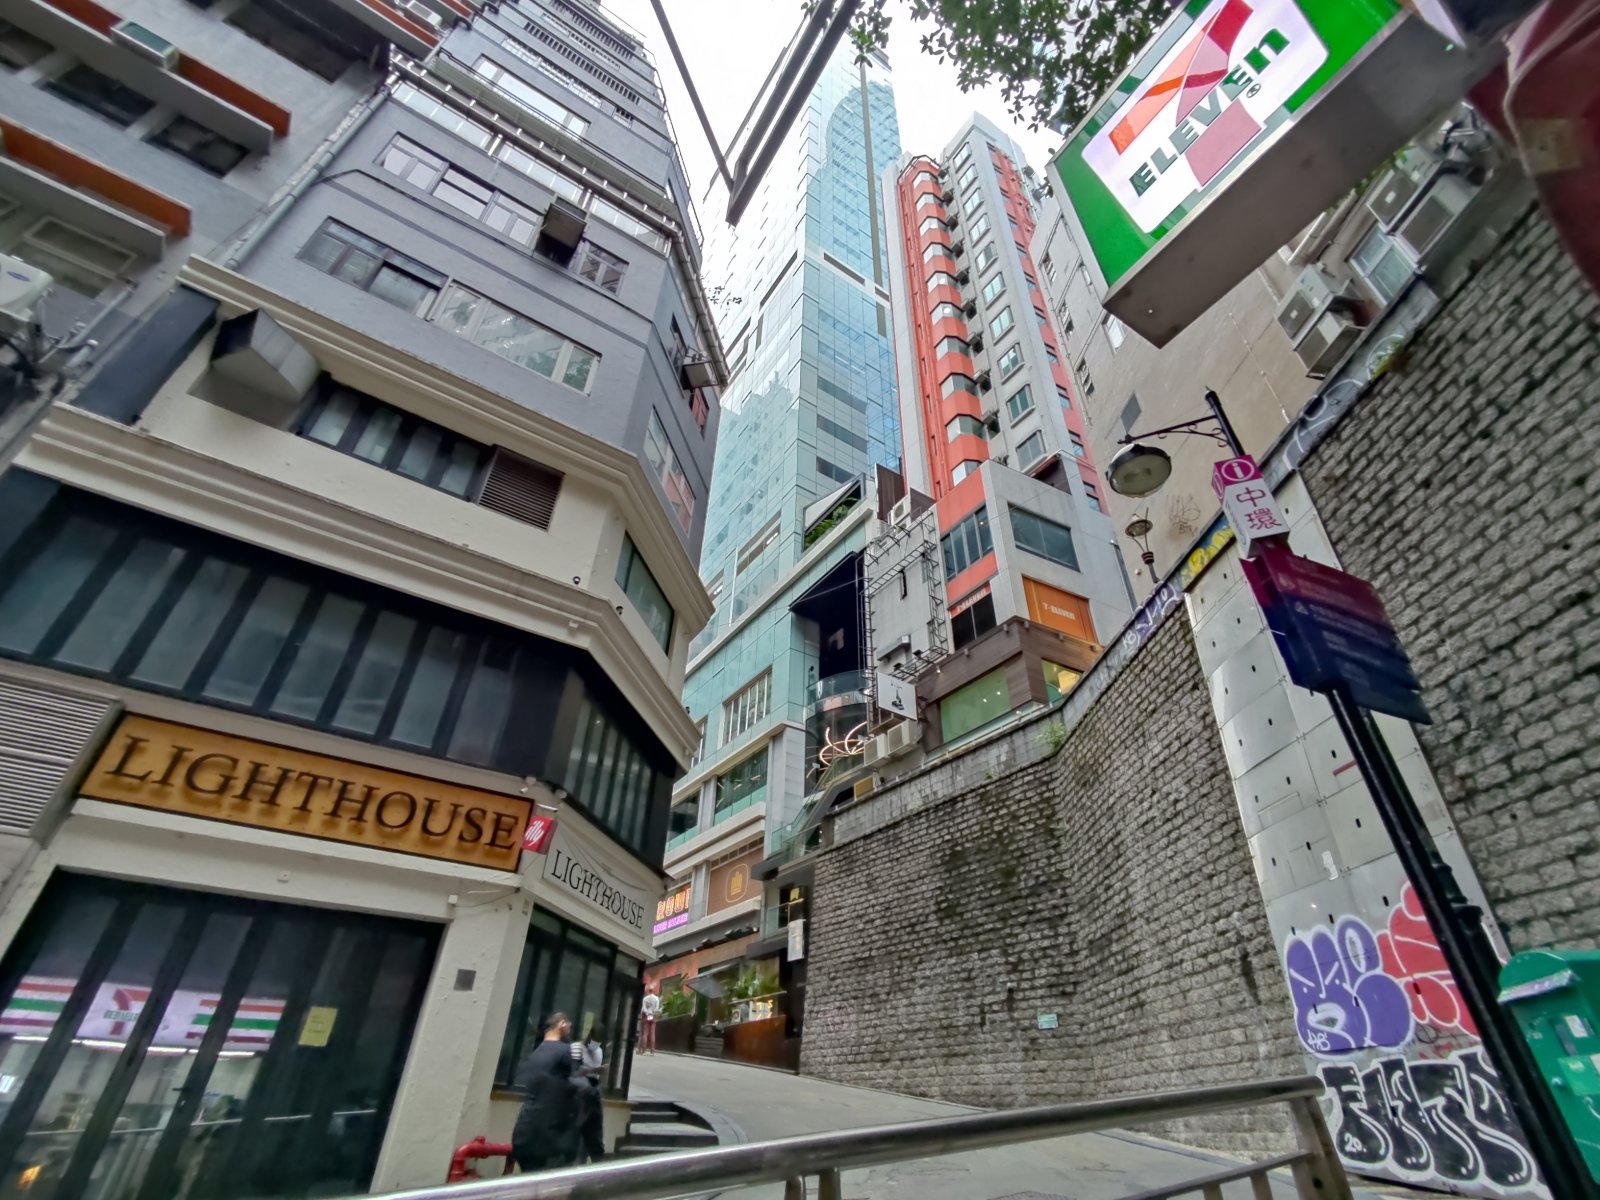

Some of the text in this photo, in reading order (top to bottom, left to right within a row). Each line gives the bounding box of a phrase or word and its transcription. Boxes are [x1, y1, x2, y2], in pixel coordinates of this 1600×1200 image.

[1129, 28, 1290, 197] ELEVEn
[1236, 486, 1283, 531] 中環
[105, 734, 519, 850] LIGHTHOUSE
[525, 819, 545, 847] illy
[551, 849, 645, 929] LIGHTHOUSE
